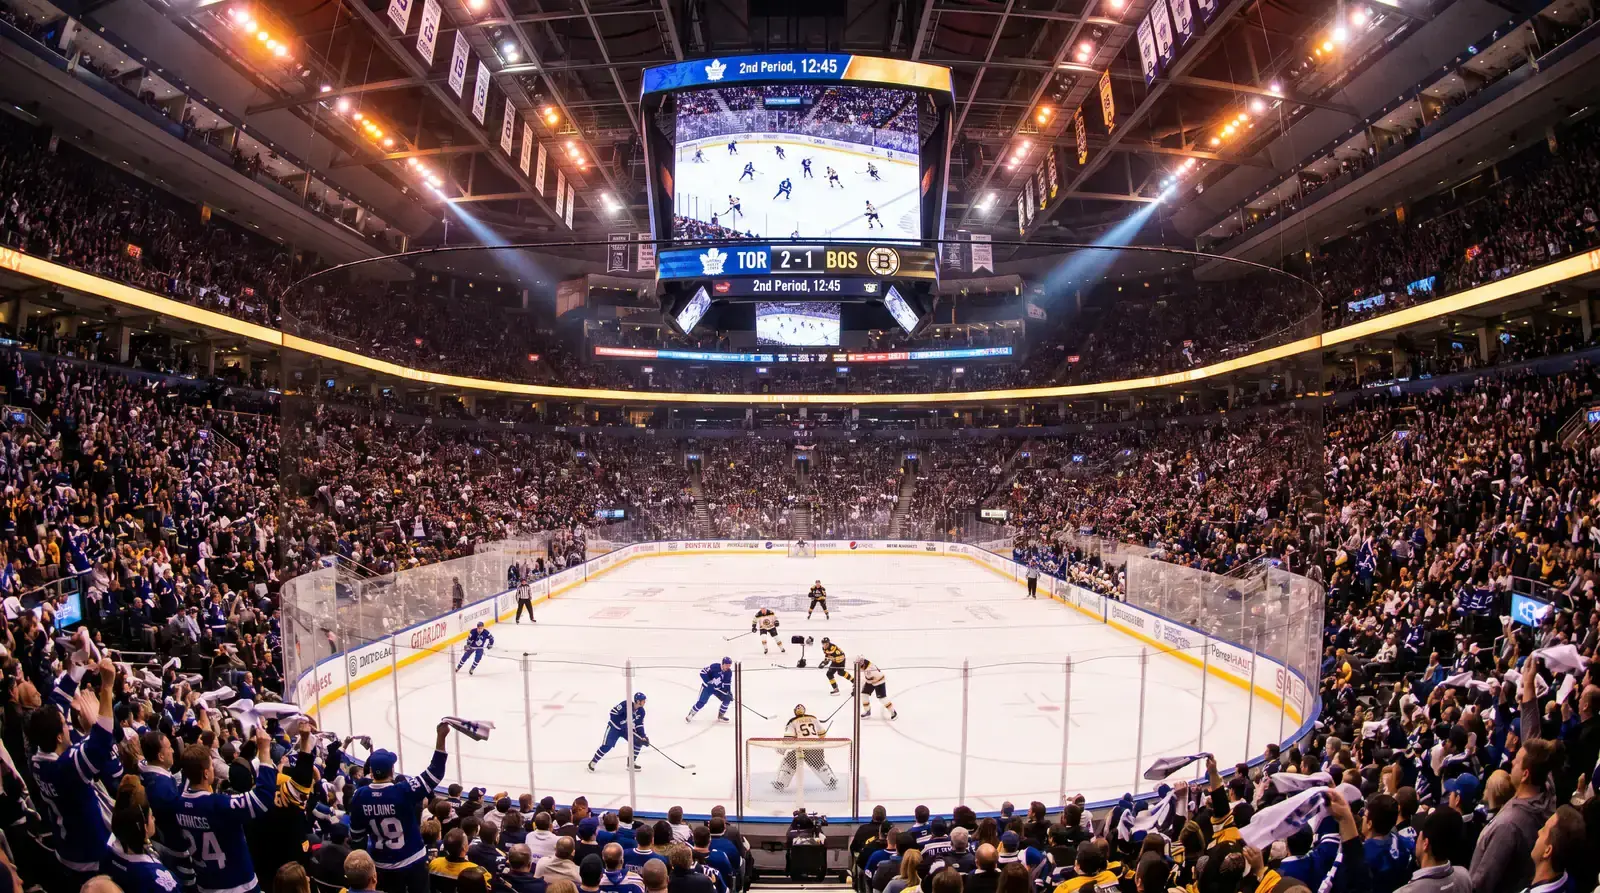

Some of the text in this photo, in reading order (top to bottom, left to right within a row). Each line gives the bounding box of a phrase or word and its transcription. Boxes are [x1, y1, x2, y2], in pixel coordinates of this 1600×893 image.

[739, 59, 837, 74] 2nd Period, 12:45
[737, 251, 767, 269] TOR
[826, 251, 858, 269] BOS
[753, 279, 841, 292] 2nd Period, 12:45
[799, 723, 818, 737] 53
[369, 817, 406, 850] 19
